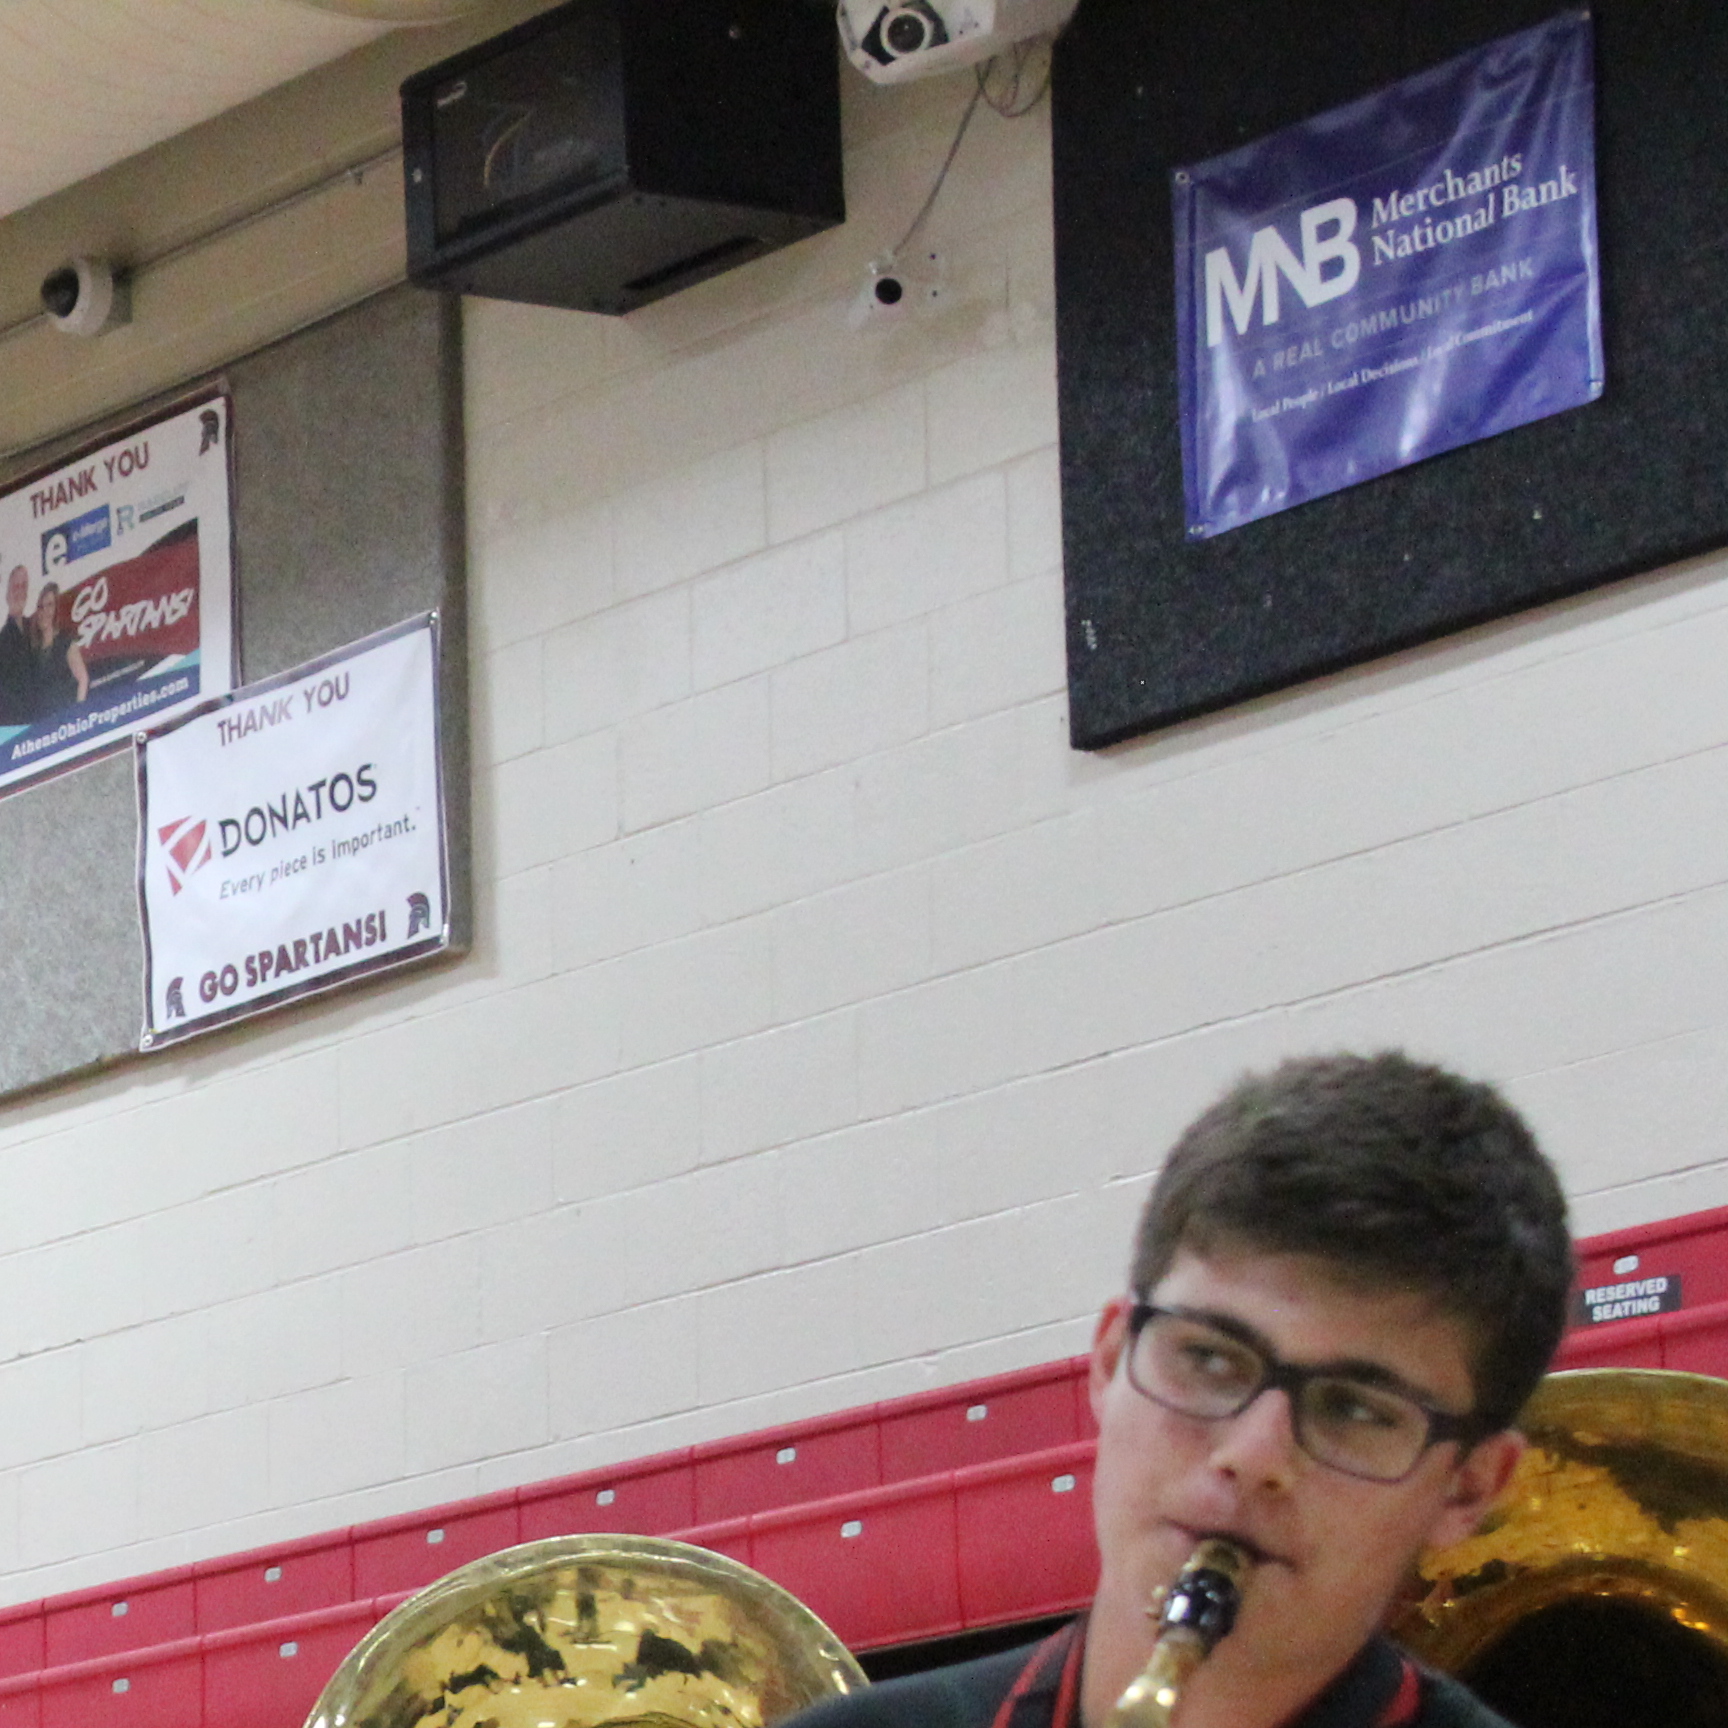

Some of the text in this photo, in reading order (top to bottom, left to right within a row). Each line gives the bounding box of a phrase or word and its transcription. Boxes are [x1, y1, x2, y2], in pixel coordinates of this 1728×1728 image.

[1370, 152, 1523, 229] Merchants
[1372, 165, 1577, 266] National Bank
[1205, 198, 1360, 347] MNB
[1253, 257, 1534, 379] A REAL COMMUNITY BANK
[1252, 401, 1280, 423] Local
[1328, 371, 1358, 394] Local
[30, 465, 98, 519] THANK
[103, 441, 149, 483] YOU
[71, 577, 108, 622] GO
[76, 588, 194, 648] SPARTANS!
[11, 677, 189, 760] AthensOhioProperties.com
[217, 672, 350, 746] THANK YOU
[219, 763, 377, 858] DONATOS
[219, 814, 417, 899] Every piece is important.
[200, 970, 238, 1003] GO
[1585, 1277, 1668, 1305] RESERVED
[1592, 1296, 1660, 1322] SEATING
